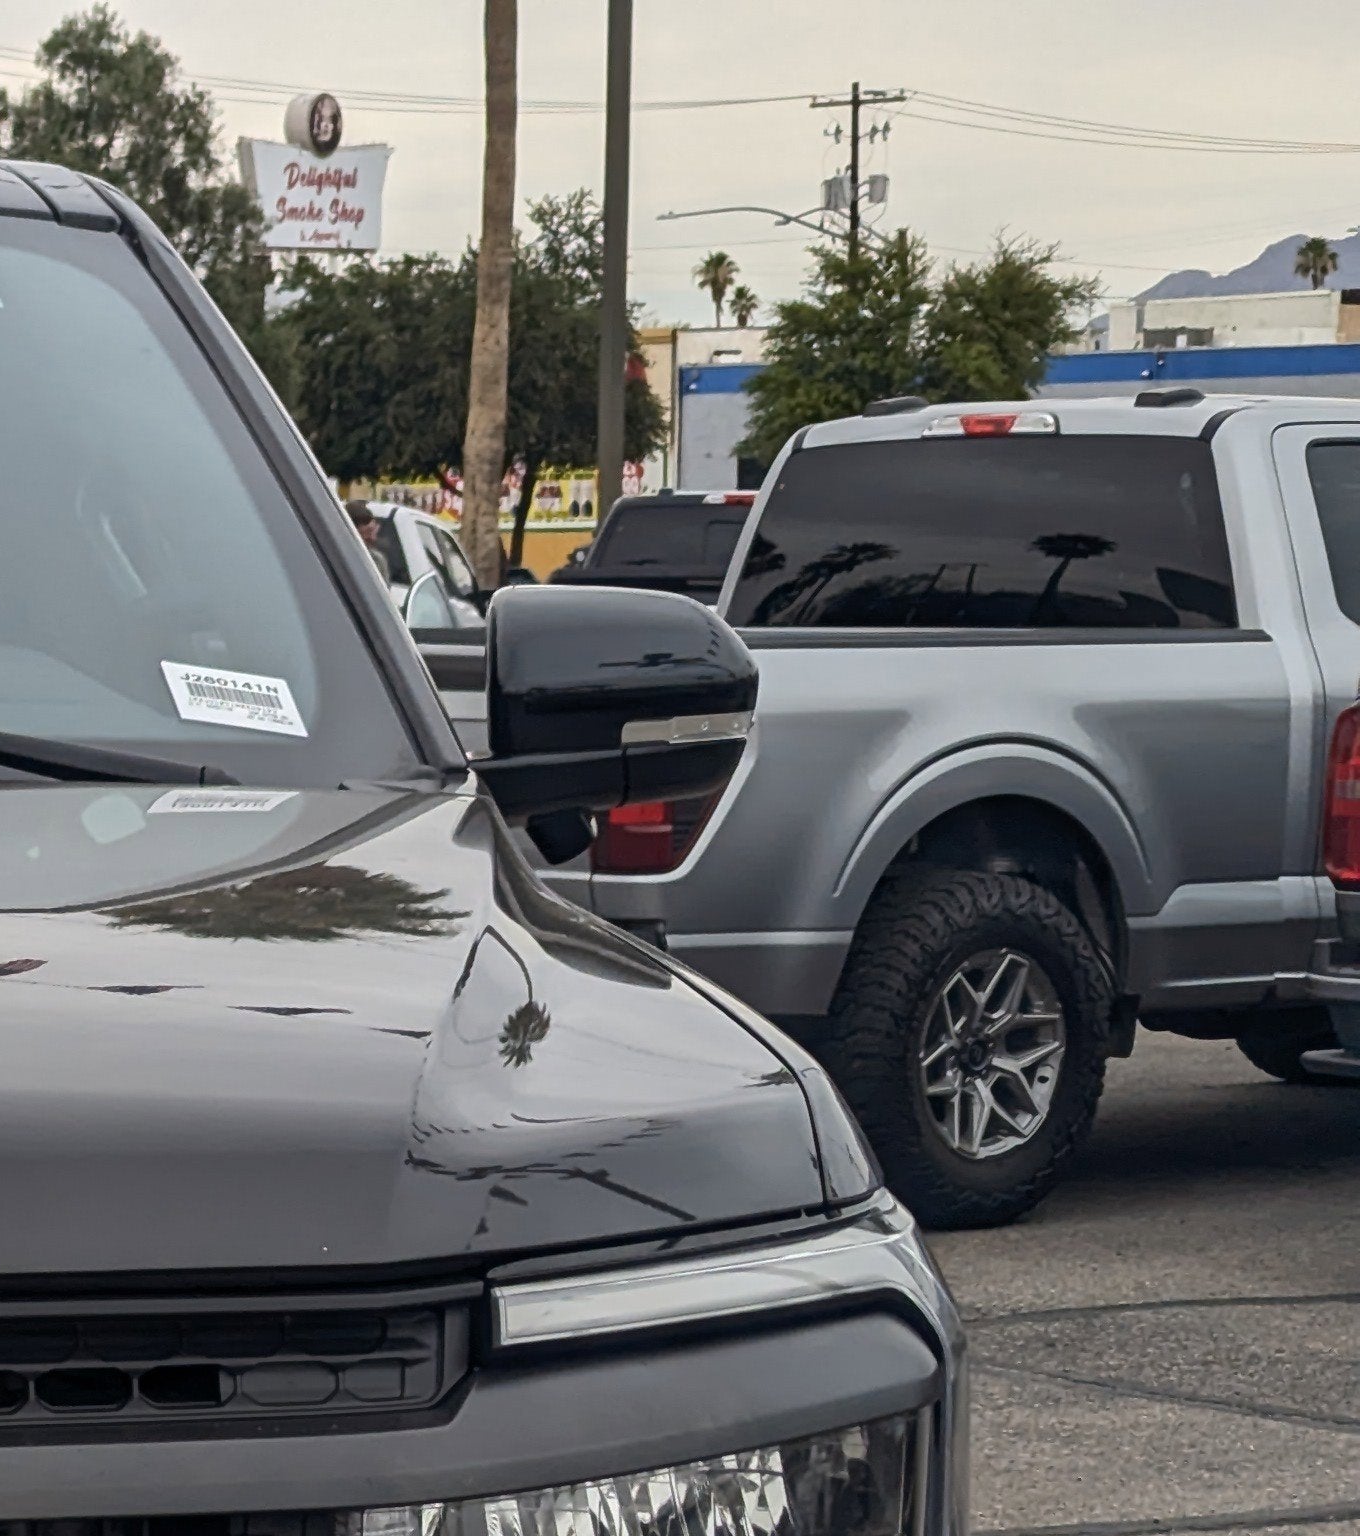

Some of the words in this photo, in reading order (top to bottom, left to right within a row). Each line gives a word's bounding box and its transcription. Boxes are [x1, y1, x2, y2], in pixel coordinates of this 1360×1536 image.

[283, 162, 359, 195] Delightful
[275, 196, 323, 223] Smoke
[328, 198, 364, 230] Shop
